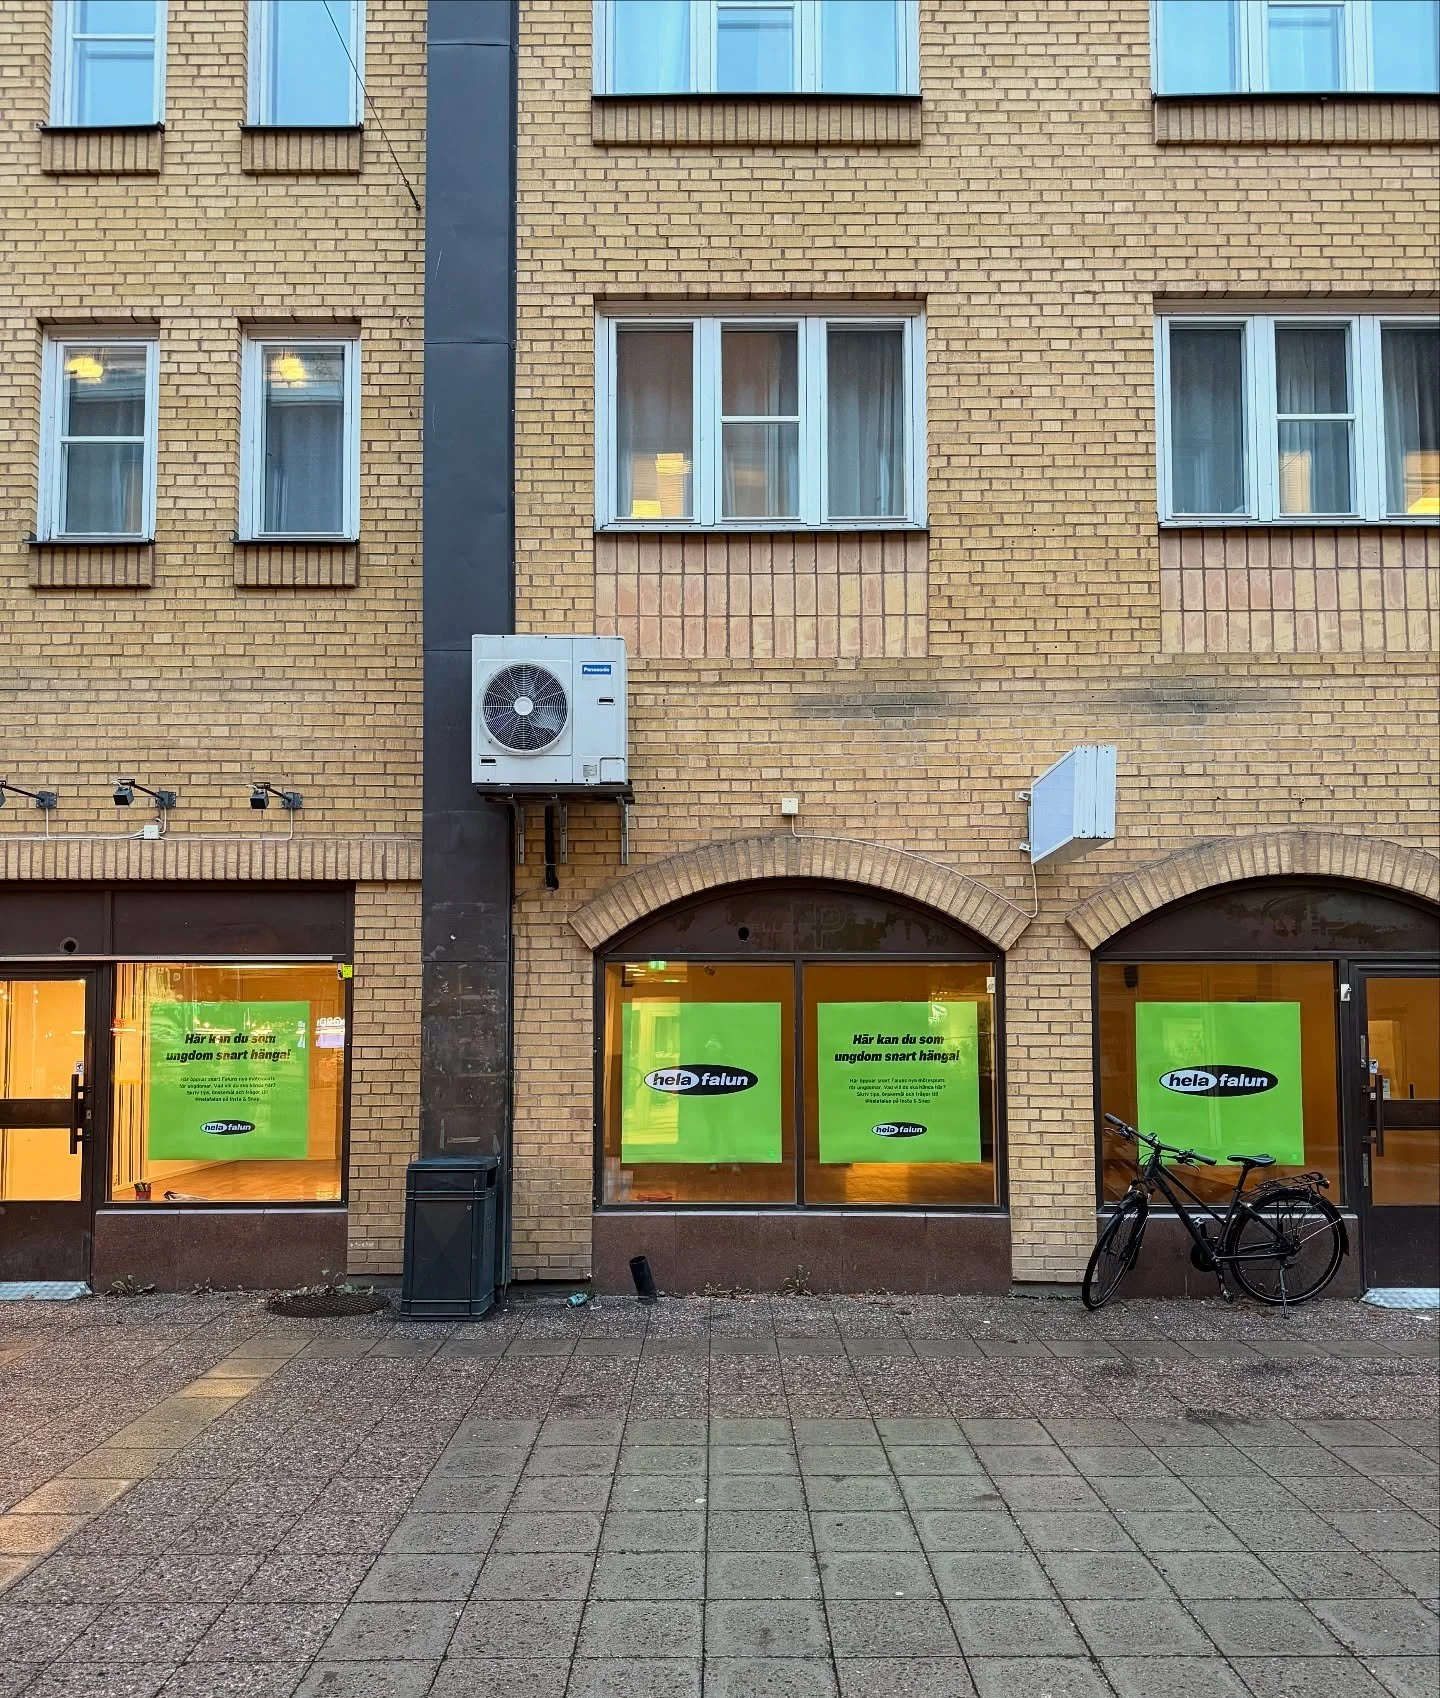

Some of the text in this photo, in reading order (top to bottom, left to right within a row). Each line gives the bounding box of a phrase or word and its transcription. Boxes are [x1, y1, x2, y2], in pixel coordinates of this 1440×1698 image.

[185, 1033, 276, 1044] Här kan du som
[853, 1034, 944, 1044] Här kan du som
[166, 1049, 291, 1063] ungdom snart hänga!
[835, 1050, 960, 1064] ungdom snart hänga!
[652, 1072, 749, 1086] hela falun
[1168, 1073, 1268, 1087] hela falun
